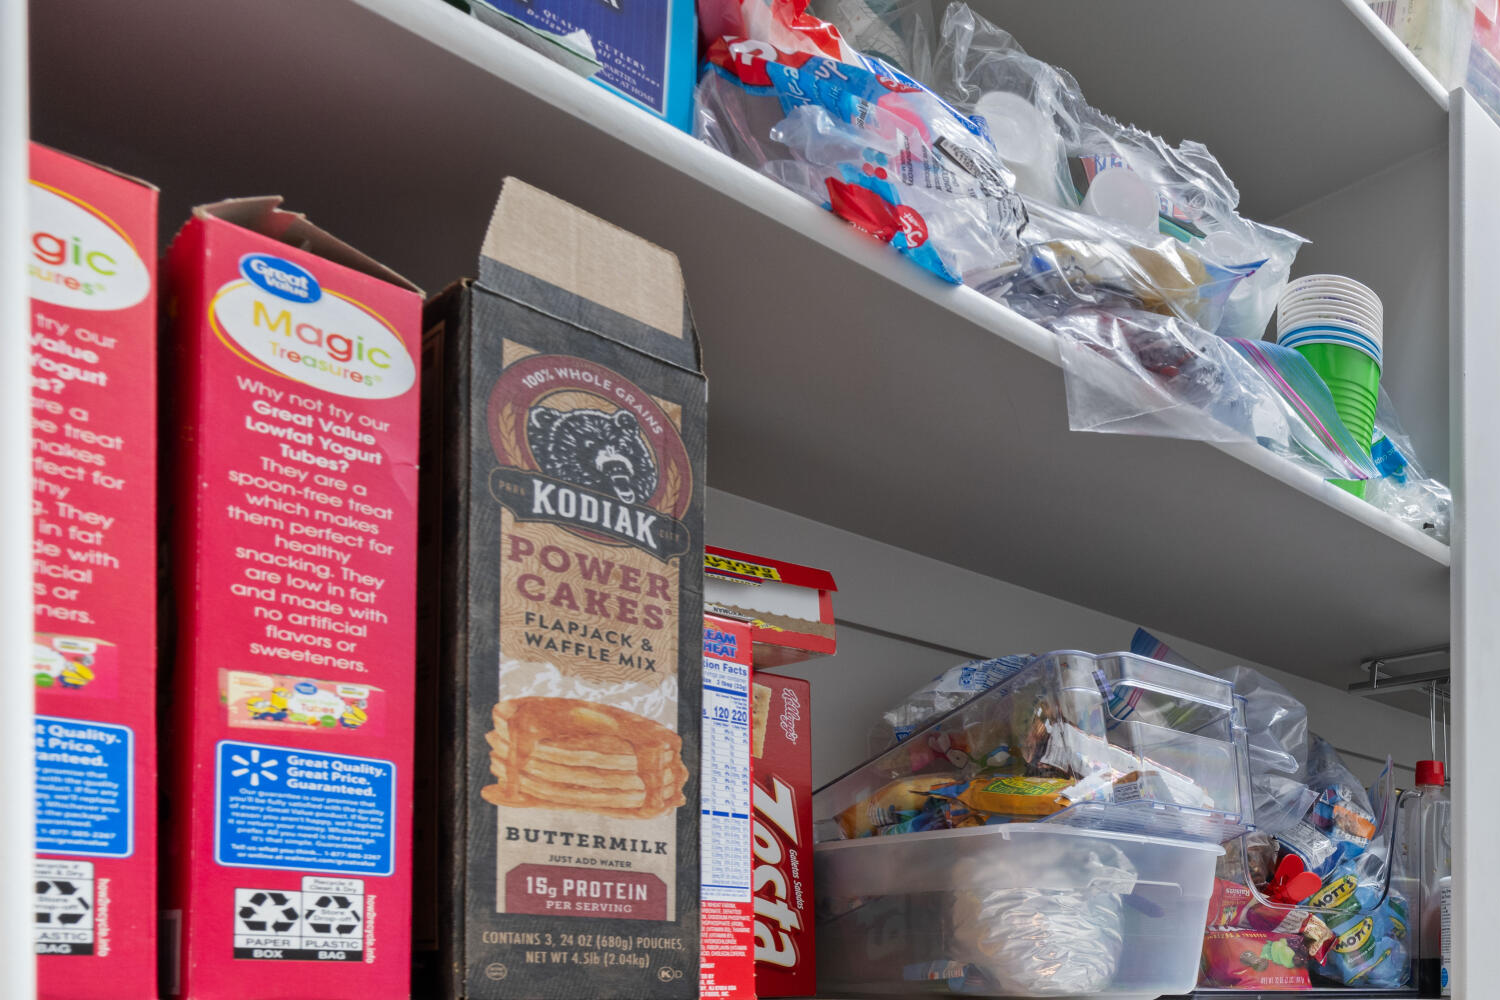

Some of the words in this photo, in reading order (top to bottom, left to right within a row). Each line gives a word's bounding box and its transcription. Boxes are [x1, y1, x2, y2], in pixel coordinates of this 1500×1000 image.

[31, 230, 118, 278] gic
[251, 259, 309, 290] Great
[265, 277, 309, 299] Value
[252, 300, 392, 370] Magic
[270, 341, 374, 387] Treasures
[236, 376, 283, 402] Why
[290, 395, 323, 413] not
[329, 405, 353, 423] try
[358, 415, 390, 432] our
[522, 368, 555, 389] 100%
[555, 367, 612, 391] WHOLE
[615, 387, 664, 436] GRAINS
[252, 400, 314, 428] Great
[319, 417, 376, 445] Value
[532, 478, 657, 550] KODIAK
[506, 534, 672, 603] POWER
[516, 573, 665, 631] CAKES
[525, 611, 633, 648] FLAPJACK
[642, 638, 653, 653] &
[525, 631, 611, 663] WAFFLE
[618, 652, 657, 672] MIX
[723, 664, 747, 677] Facts
[287, 755, 327, 772] Great
[332, 762, 388, 778] Quality.
[287, 767, 327, 781] Great
[332, 772, 371, 787] Price.
[286, 778, 377, 798] Guaranteed.
[505, 826, 668, 856] BUTTERMILK
[548, 854, 573, 864] JUST
[575, 857, 597, 866] ADD
[600, 858, 632, 869] WATER
[753, 776, 801, 968] Tosta
[526, 876, 557, 899] 15g
[563, 879, 648, 901] PROTEIN
[1313, 876, 1356, 908] MOTT'S
[546, 901, 572, 911] PER
[574, 903, 633, 914] SERVING
[246, 937, 292, 948] PAPER
[306, 940, 360, 950] PLASTIC
[253, 949, 283, 959] BOX
[318, 950, 346, 961] BAG
